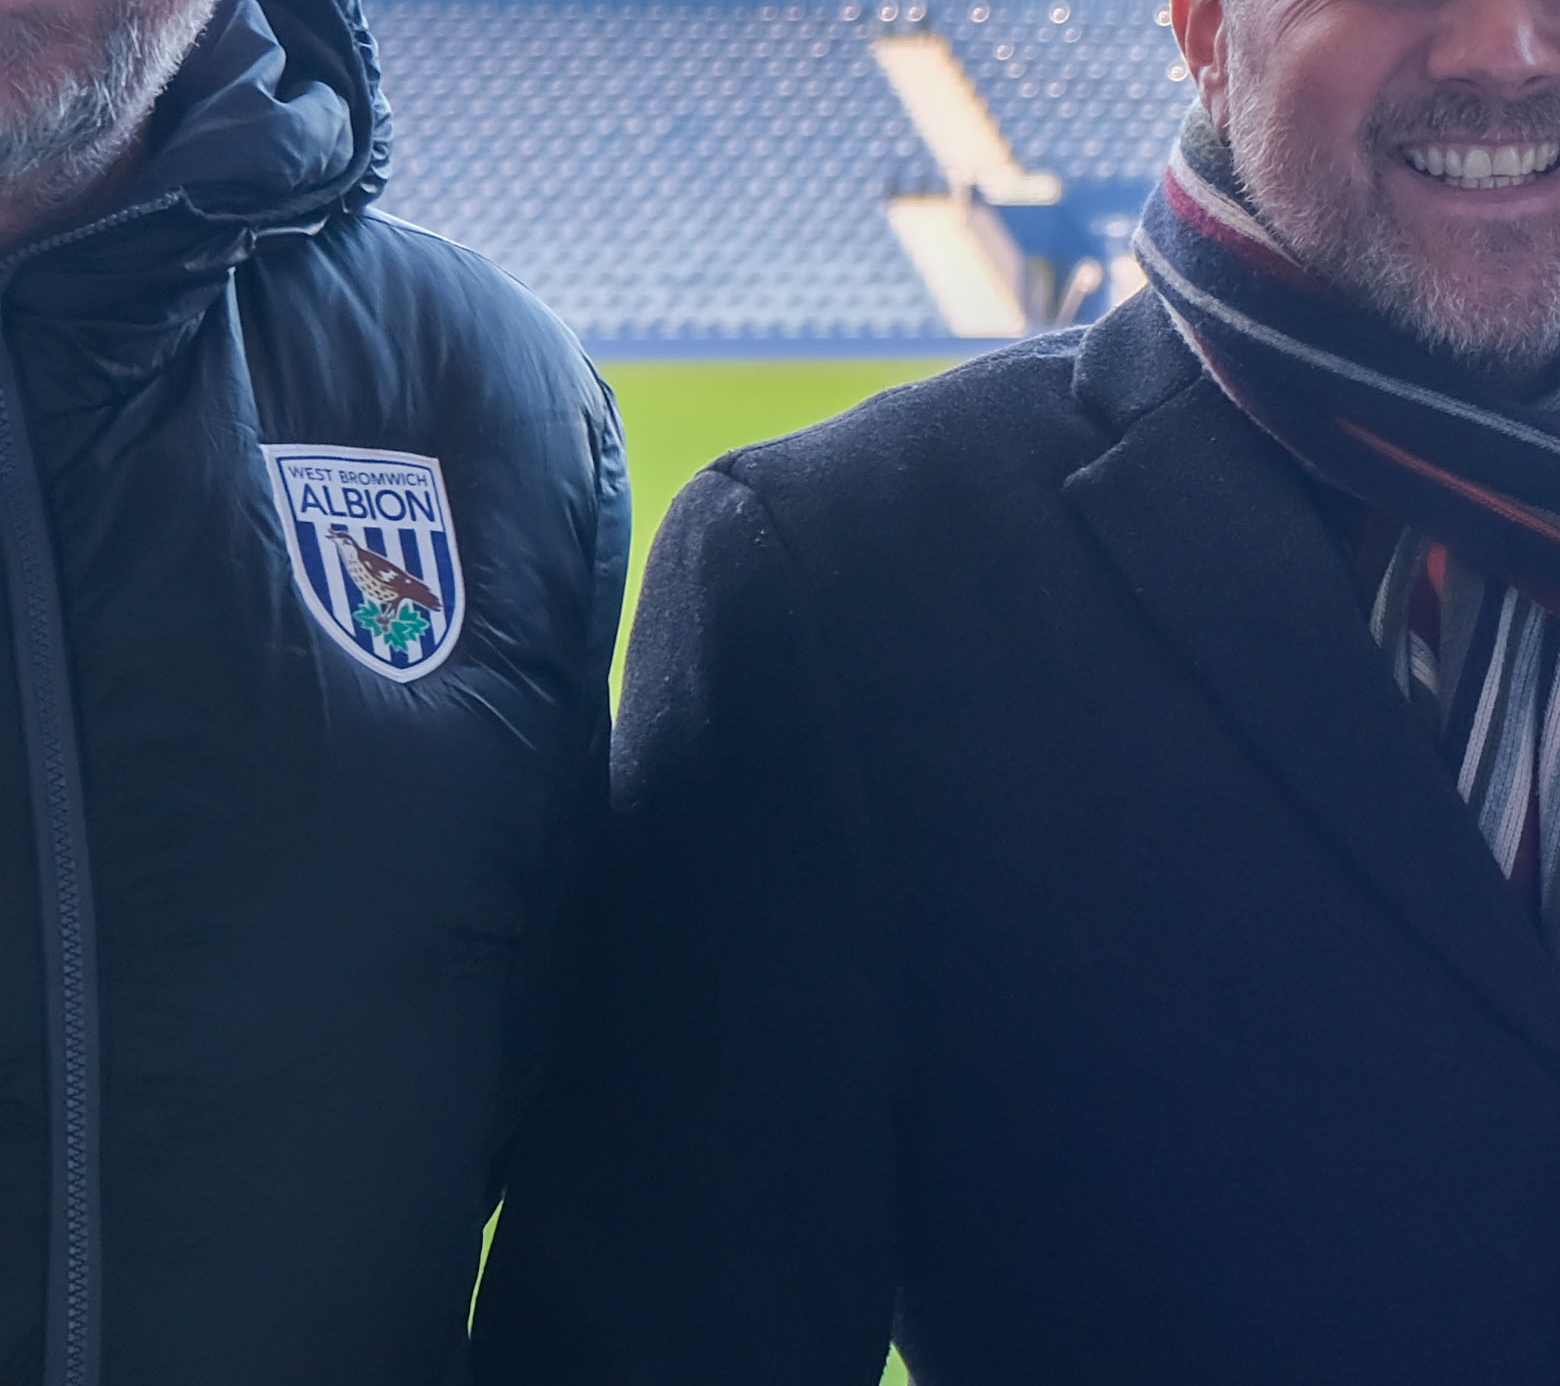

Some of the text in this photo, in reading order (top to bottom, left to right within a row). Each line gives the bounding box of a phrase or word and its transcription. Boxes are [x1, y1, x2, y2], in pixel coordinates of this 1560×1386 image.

[289, 467, 426, 486] WEST BROMWICH
[300, 483, 435, 522] ALBION
